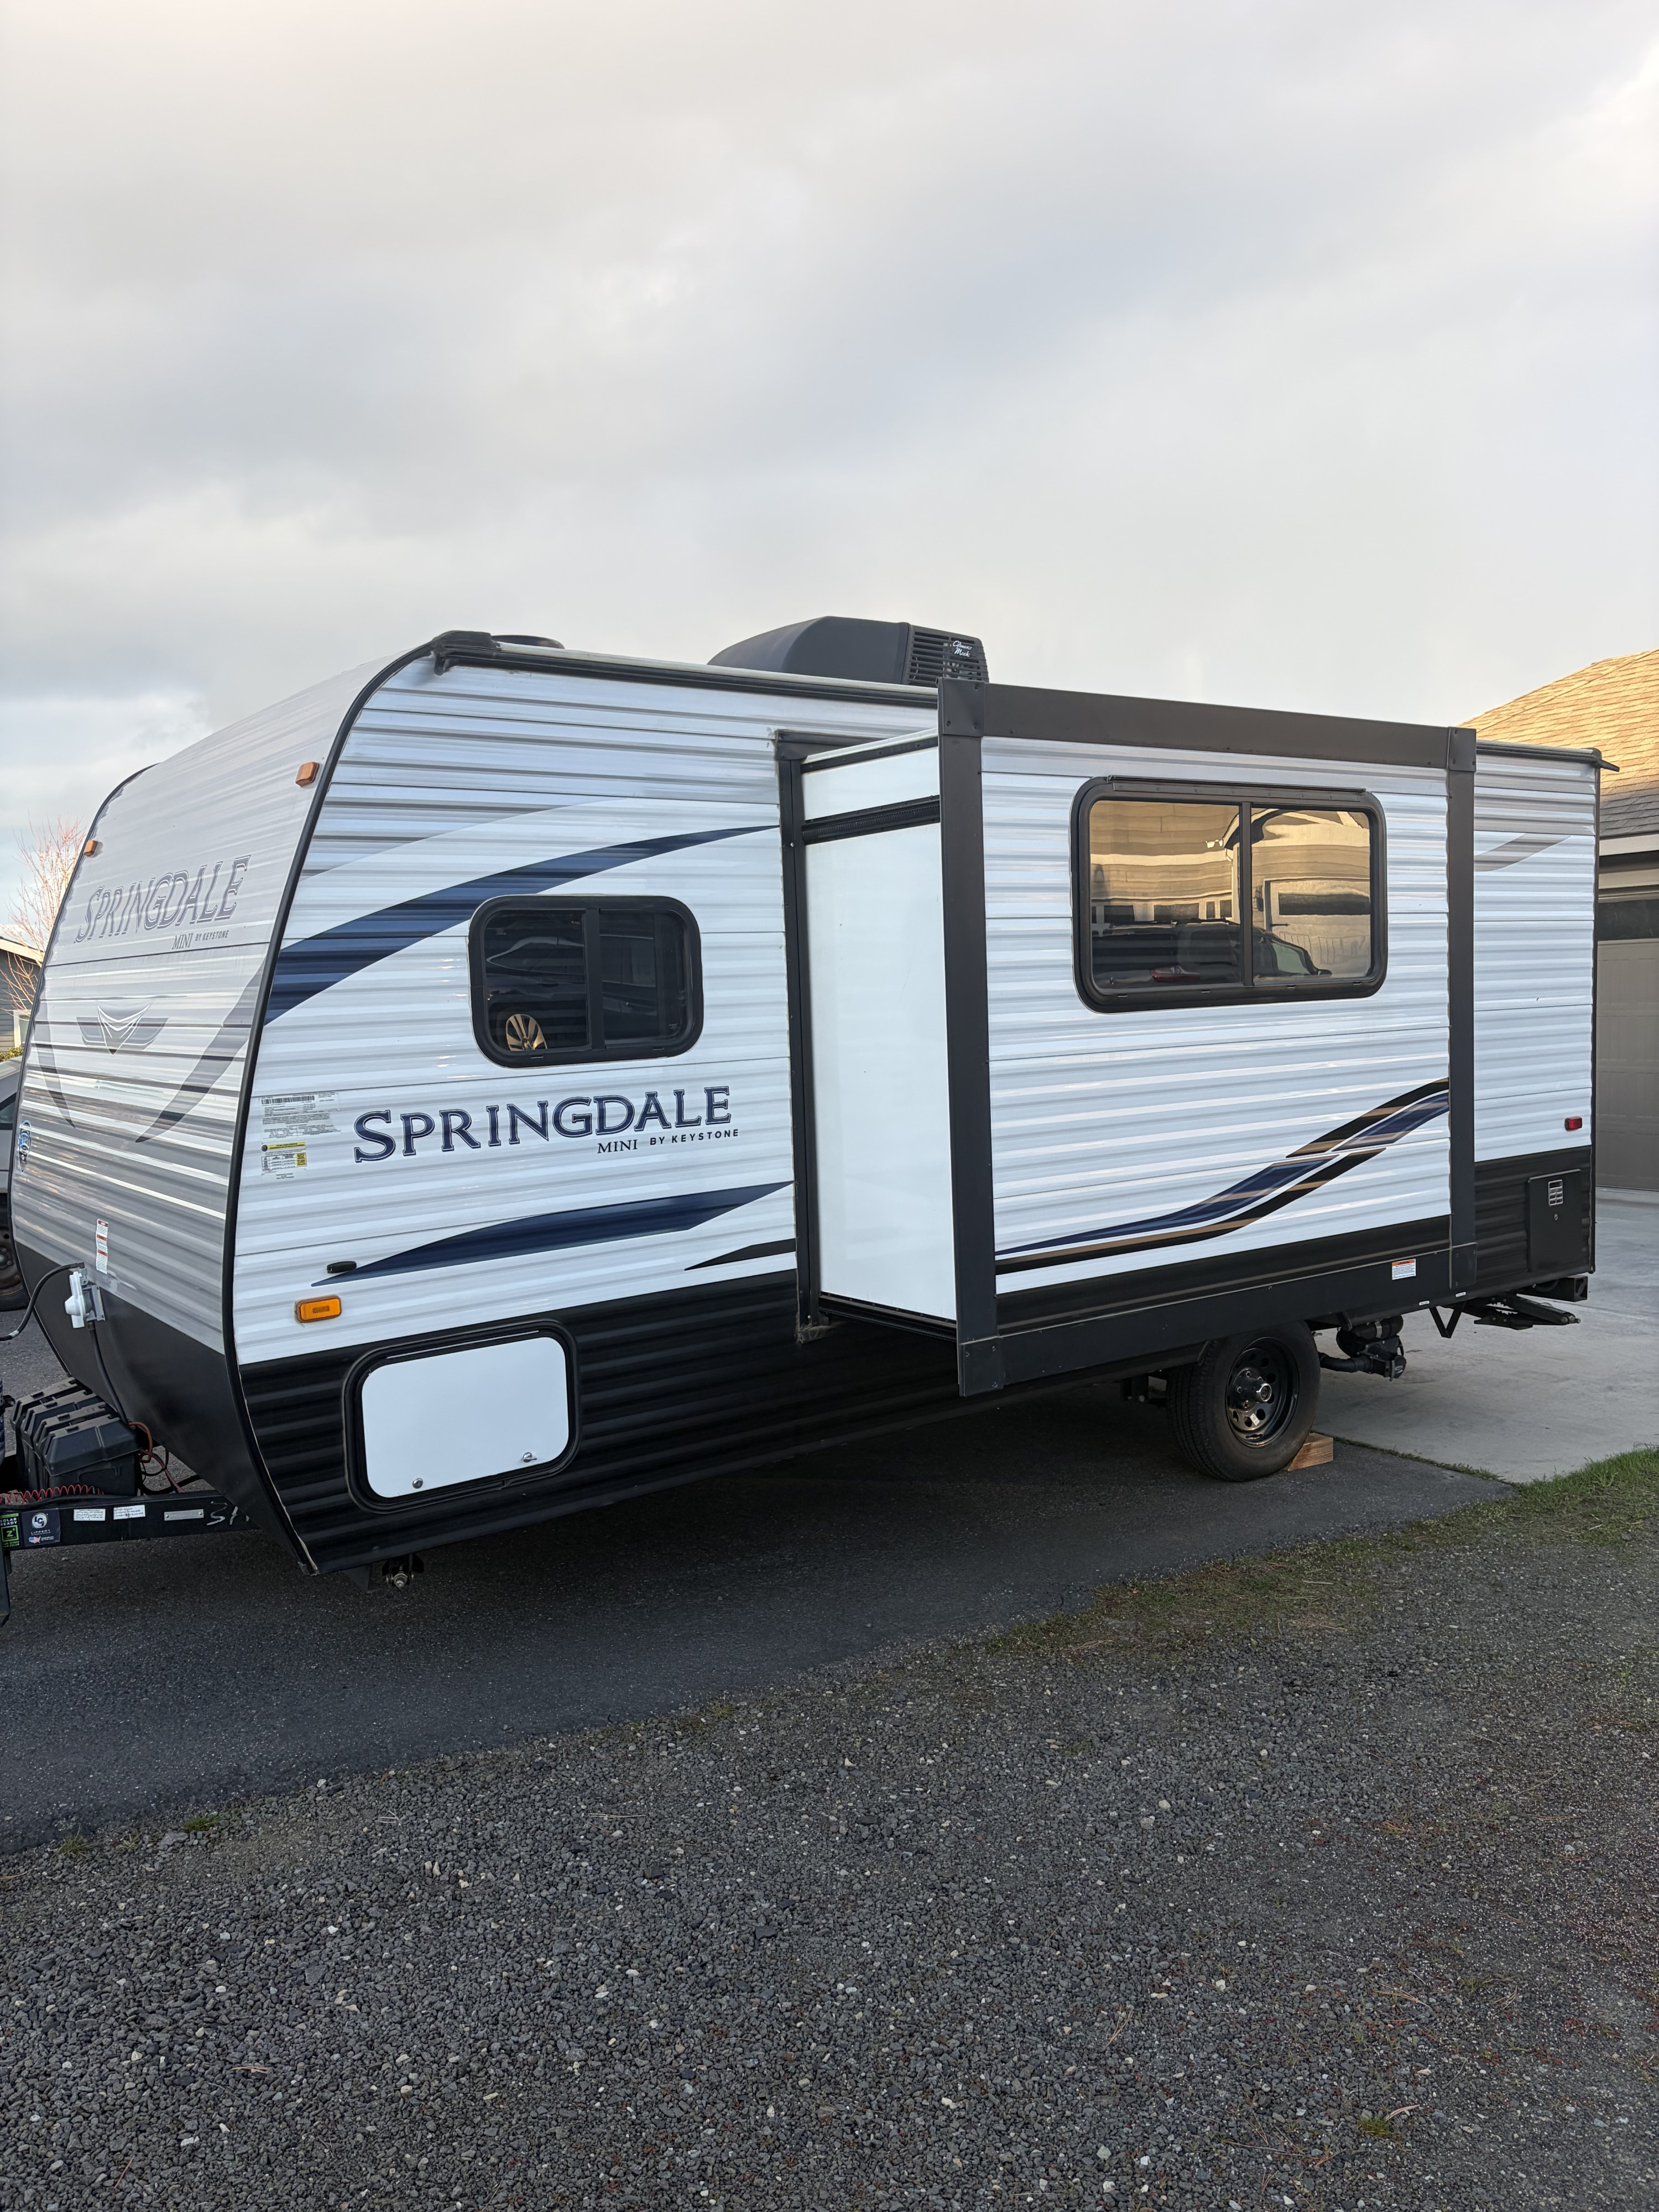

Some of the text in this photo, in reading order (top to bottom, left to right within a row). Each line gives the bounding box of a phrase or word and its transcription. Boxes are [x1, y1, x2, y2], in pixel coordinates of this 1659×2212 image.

[74, 854, 251, 943] SPRINGDALE
[171, 933, 194, 950] MINI
[202, 930, 229, 941] KEYSTONE
[354, 1086, 731, 1163] SPRINGDALE
[597, 1129, 739, 1154] MINI BY KEYSTONE
